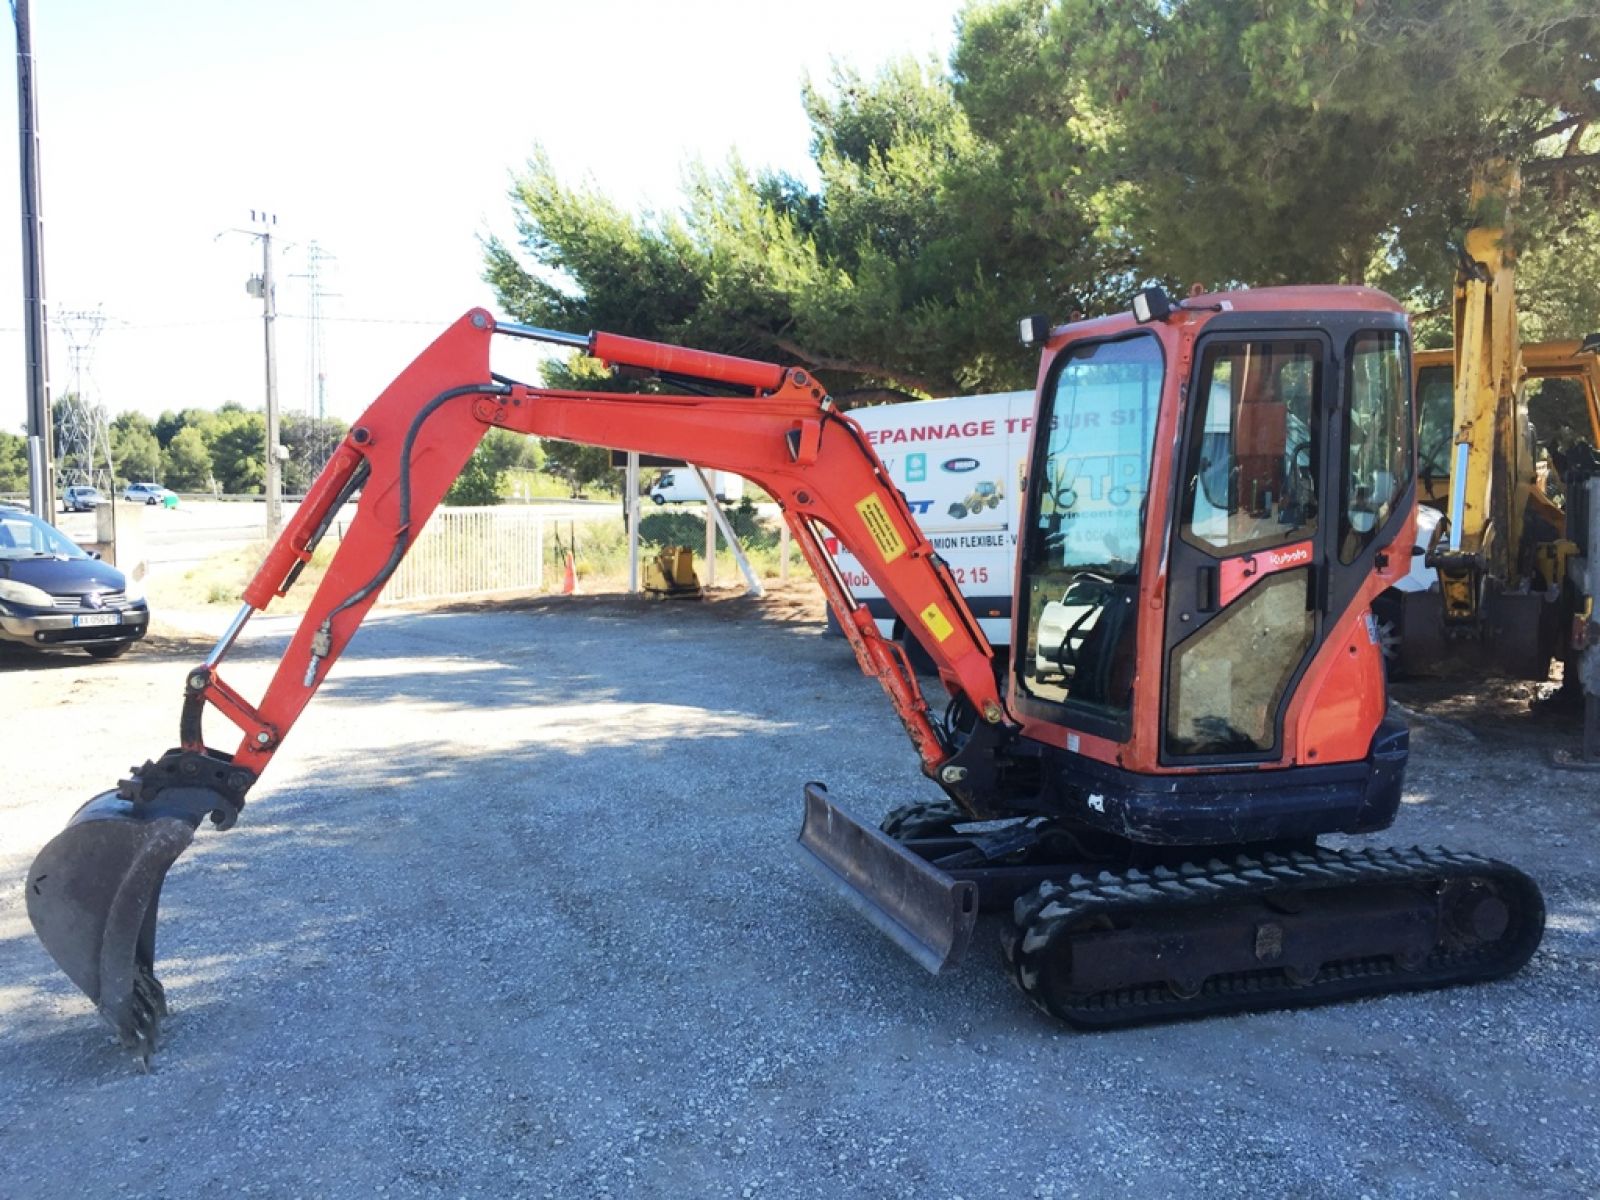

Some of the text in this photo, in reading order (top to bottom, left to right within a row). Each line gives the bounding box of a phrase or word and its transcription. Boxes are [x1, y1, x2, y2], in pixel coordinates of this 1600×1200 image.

[960, 535, 1004, 549] FLEXIBLE
[1270, 549, 1308, 565] Kubota
[970, 567, 988, 584] 15
